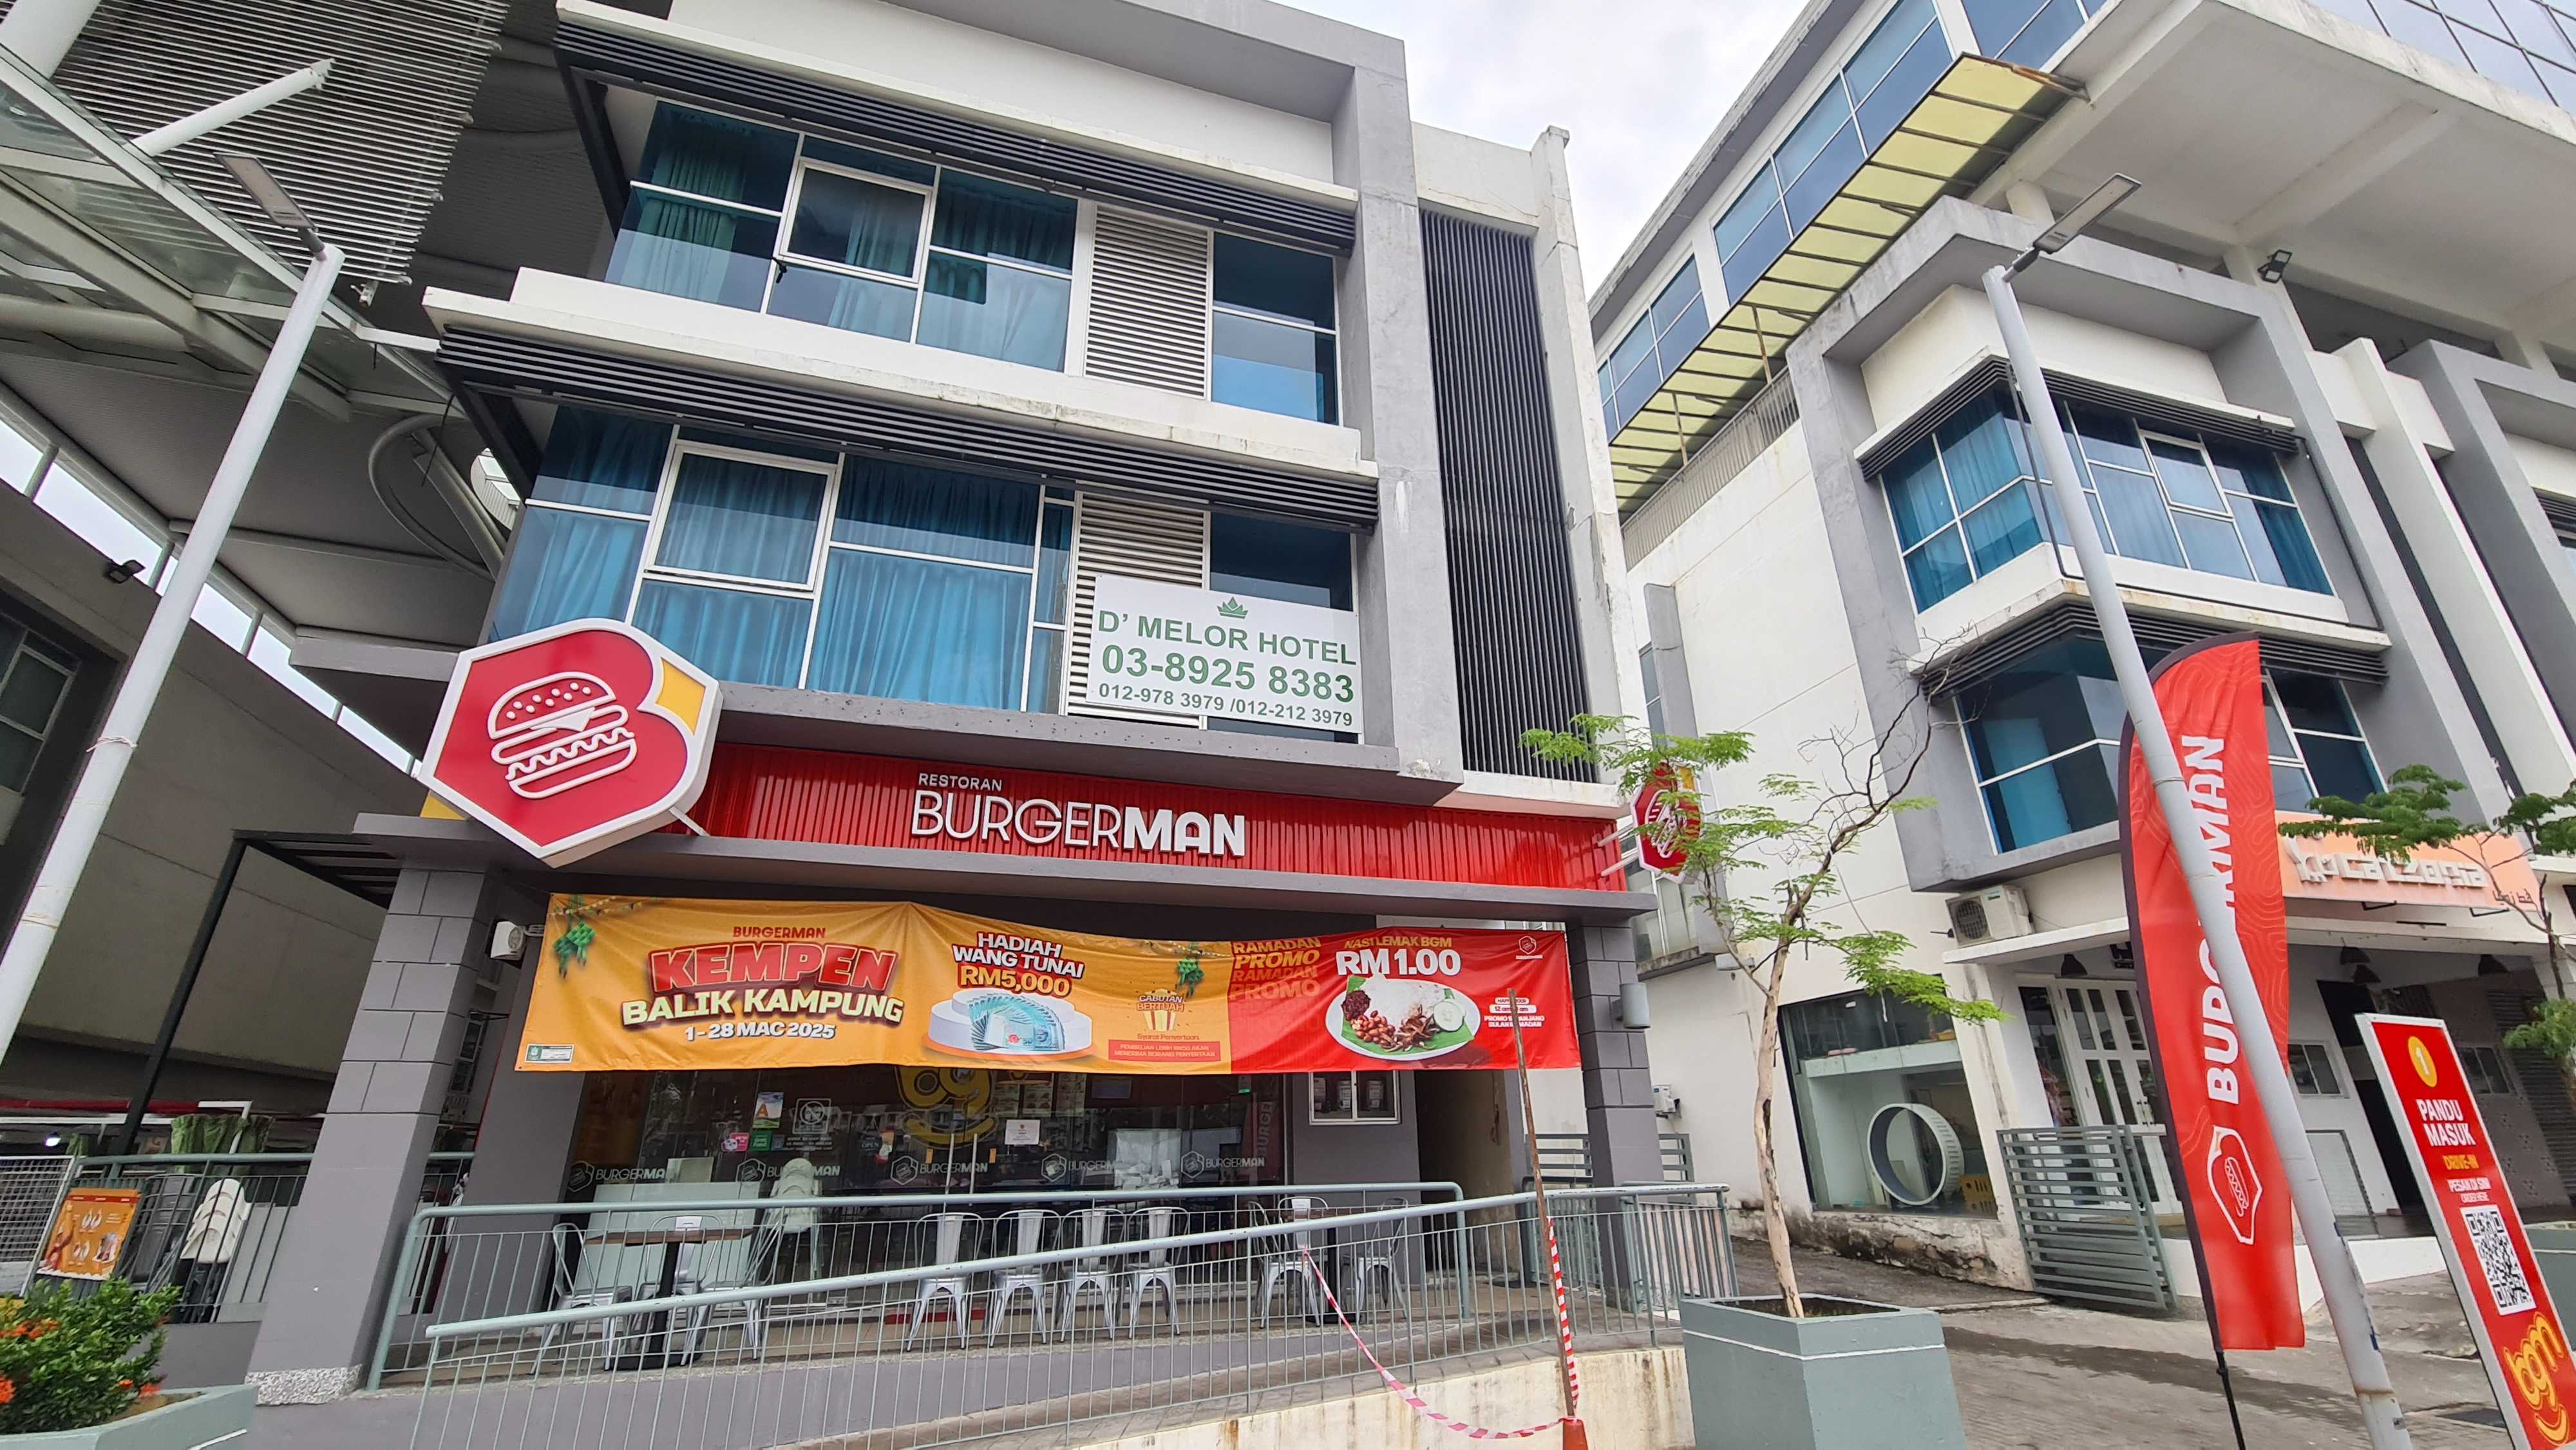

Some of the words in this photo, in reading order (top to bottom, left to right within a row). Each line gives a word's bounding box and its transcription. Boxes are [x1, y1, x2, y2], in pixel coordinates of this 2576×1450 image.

[1139, 616, 1248, 650] MELOR
[1259, 632, 1356, 665] HOTEL
[1103, 645, 1255, 690] 03-8925
[1269, 666, 1353, 702] 8383
[1099, 683, 1173, 705] 012-978
[1181, 693, 1224, 710] 3979
[1312, 708, 1352, 726] 3979
[918, 773, 1002, 791] RESTORAN
[911, 789, 1245, 857] BURGERMAN
[734, 927, 825, 939] BURGERMAN
[1377, 936, 1418, 947] LEMAK
[1421, 937, 1452, 947] BGM
[978, 933, 1062, 957] HADIAH
[1233, 937, 1321, 954] RAMADAN
[650, 943, 896, 992] KEMPEN
[953, 945, 1018, 967] WANG
[1021, 954, 1084, 978] TUNAI
[1236, 950, 1320, 969] PROMO
[1335, 948, 1390, 975] RM
[961, 966, 1070, 996] RM5,000
[1231, 968, 1318, 982] RAMADAN
[1231, 980, 1320, 1000] PROMO
[623, 990, 735, 1025] BALIK
[744, 990, 904, 1021] KAMPUNG
[1137, 1003, 1184, 1012] BERTUAH
[735, 1022, 786, 1038] MAC
[789, 1023, 835, 1039] 2025
[2416, 1047, 2430, 1075] 1
[2416, 1099, 2463, 1121] PANDU
[2423, 1123, 2476, 1146] MASUK
[1206, 1158, 1265, 1168] BURGERMAN
[596, 1169, 666, 1180] BURGERMA
